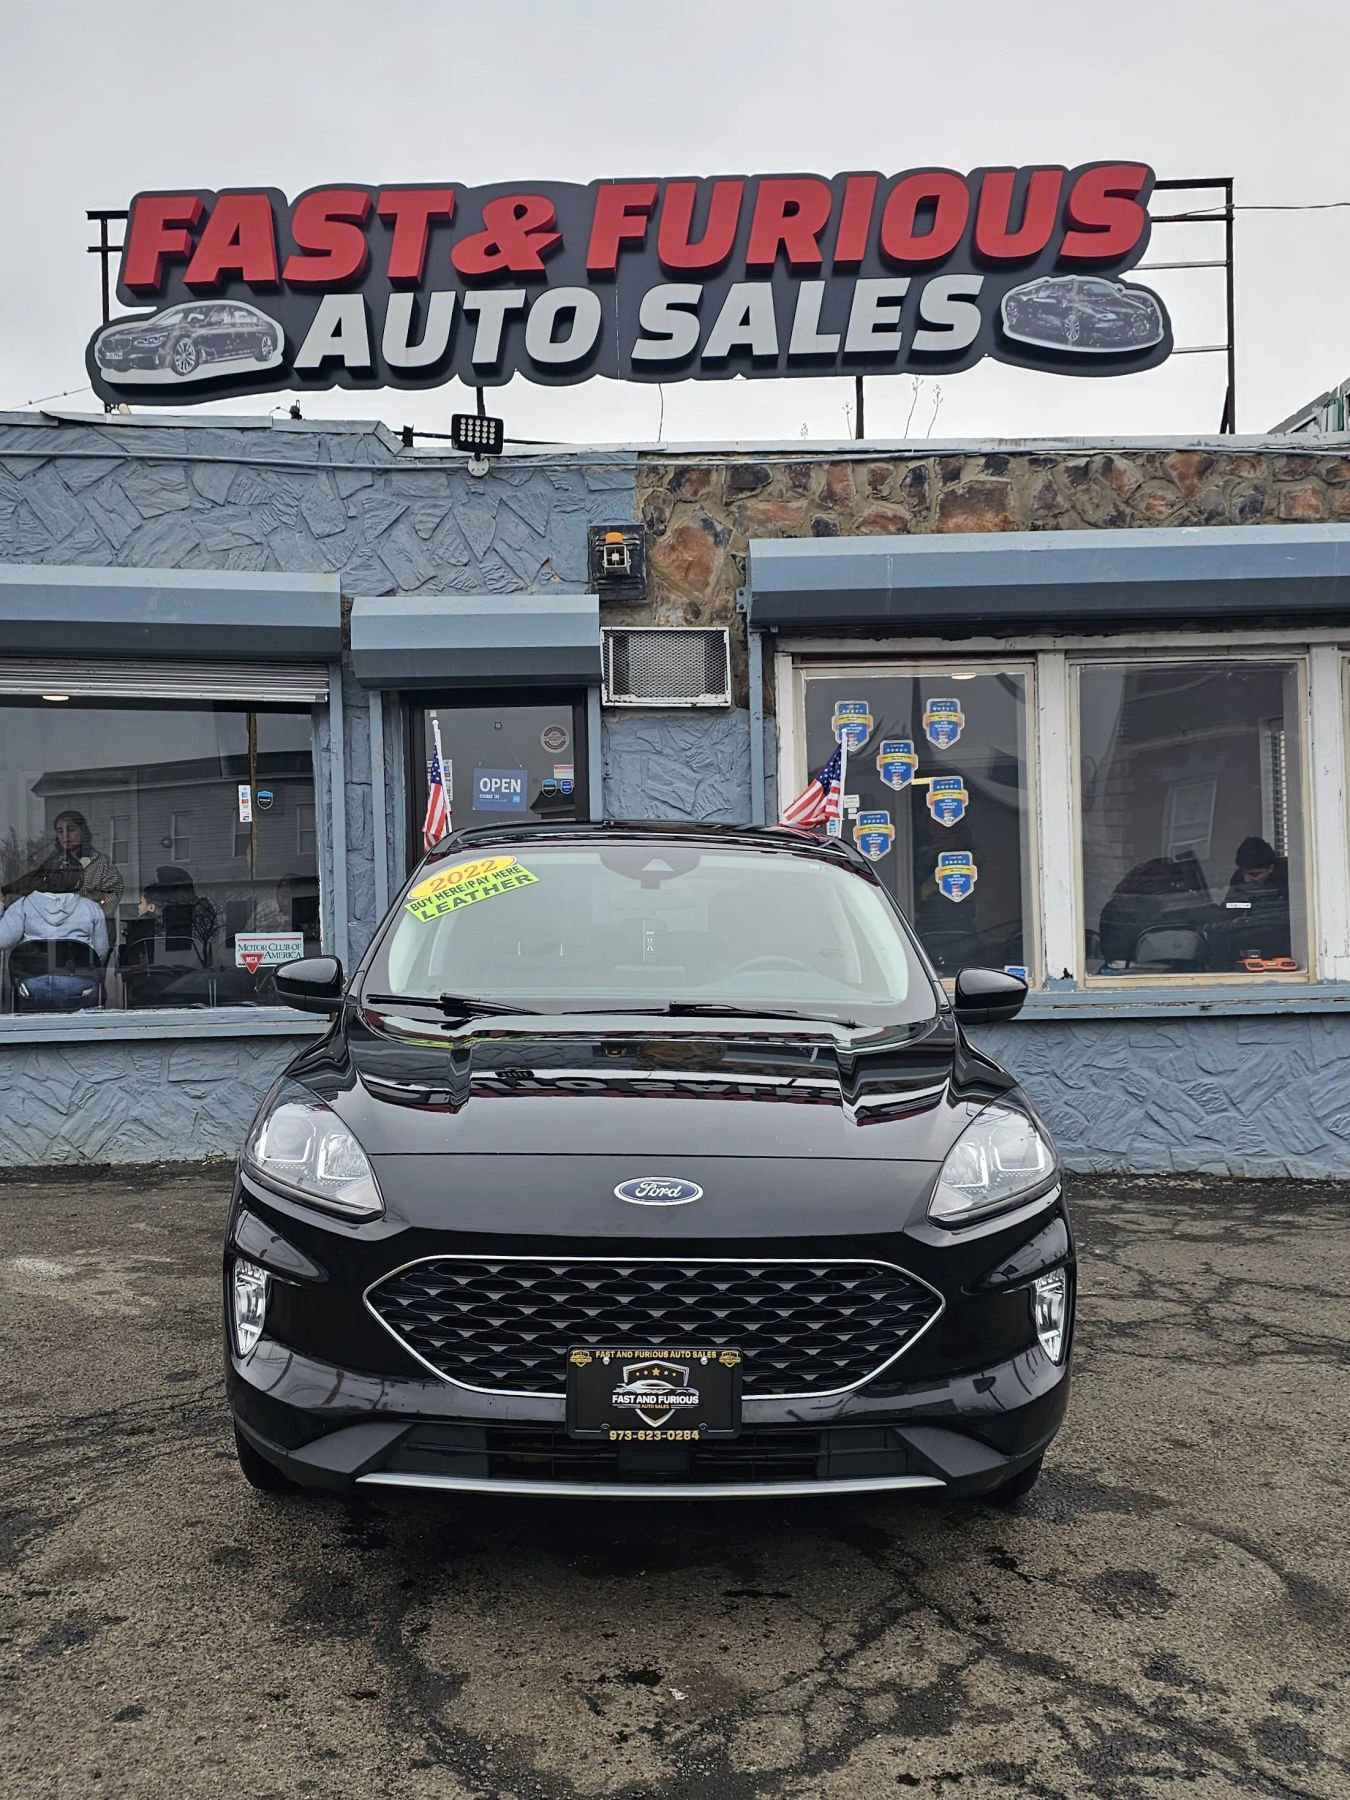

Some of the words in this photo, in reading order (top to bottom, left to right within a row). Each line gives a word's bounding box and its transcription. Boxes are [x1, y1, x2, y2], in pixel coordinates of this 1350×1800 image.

[122, 187, 455, 288] FAST
[450, 194, 563, 278] &
[585, 163, 1151, 271] FURIOUS
[292, 285, 602, 369] AUTO
[630, 274, 985, 362] SALES
[479, 777, 521, 793] OPEN
[410, 897, 435, 912] BUY
[493, 865, 523, 880] HERE
[430, 860, 498, 893] 2022
[421, 874, 534, 920] LEATHER
[635, 1181, 682, 1198] Ford
[595, 1350, 615, 1359] FAST
[616, 1350, 633, 1359] AND
[634, 1350, 668, 1359] FURIOUS
[669, 1350, 691, 1359] AUTO
[692, 1350, 717, 1359] SALES
[612, 1394, 635, 1404] FAST
[636, 1394, 657, 1404] AND
[658, 1395, 699, 1405] FURIOUS
[609, 1430, 700, 1441] 973-623-0284
